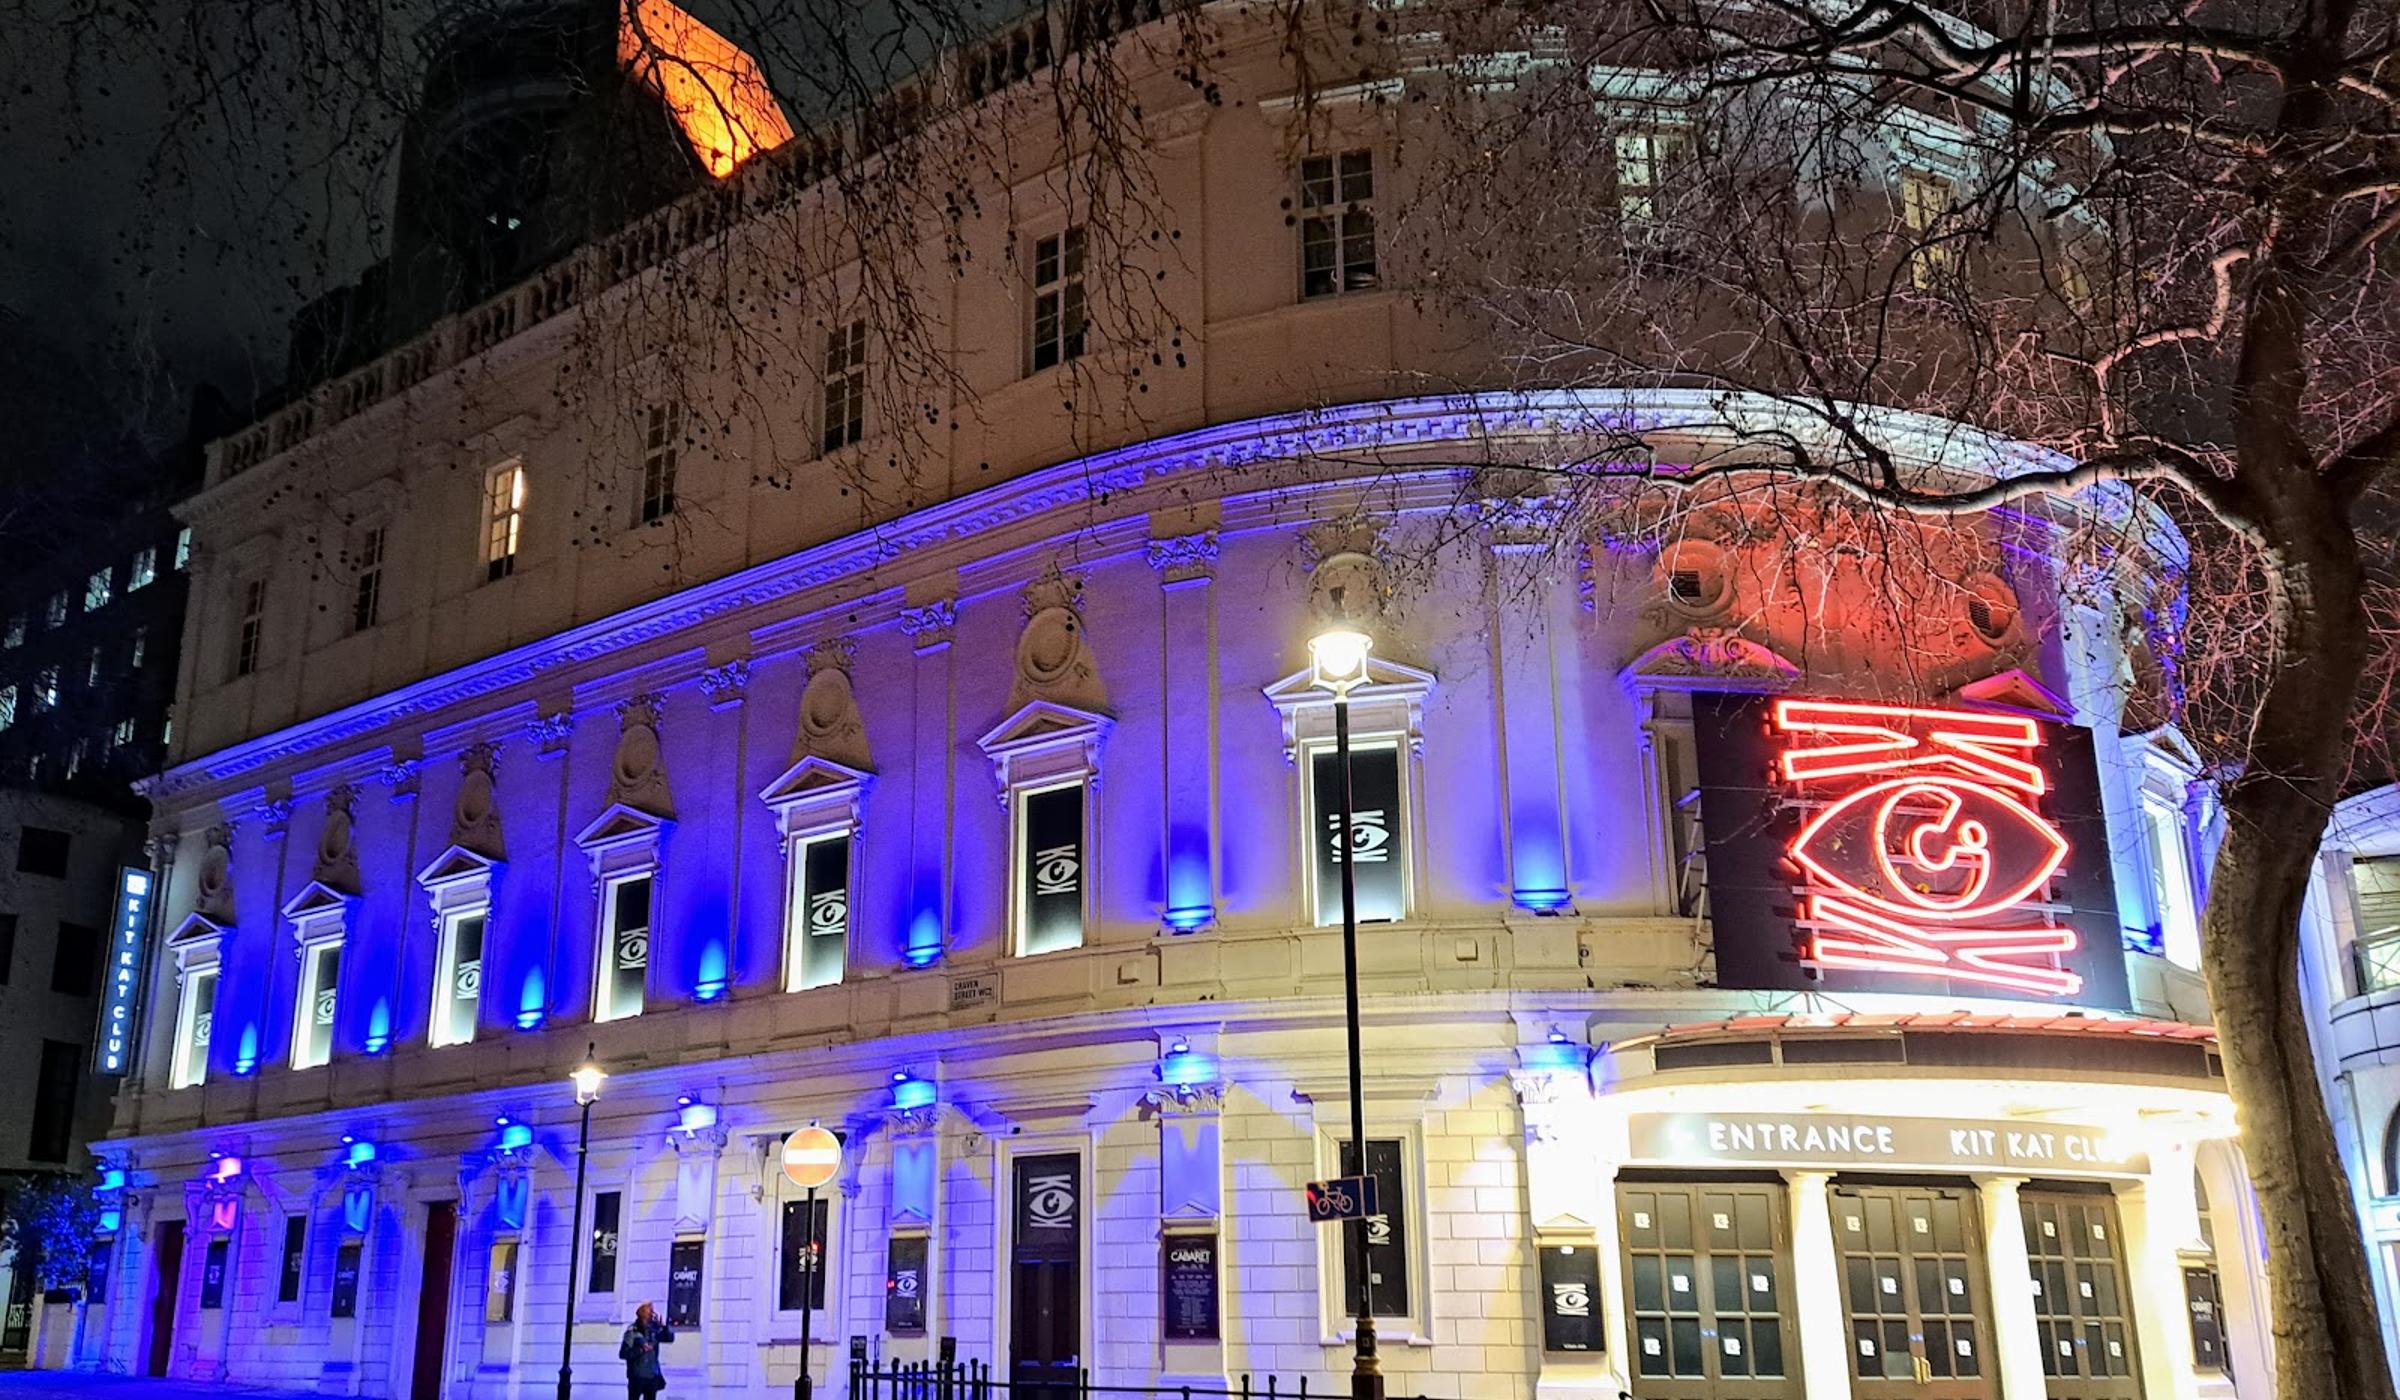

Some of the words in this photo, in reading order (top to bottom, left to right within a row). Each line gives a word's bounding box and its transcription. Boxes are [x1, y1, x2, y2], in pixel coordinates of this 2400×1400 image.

[125, 898, 139, 944] KIT
[118, 951, 133, 998] KAT
[107, 1005, 125, 1069] CLUB
[1708, 1122, 1895, 1153] ENTRANCE
[1950, 1128, 1996, 1156] KIT
[2007, 1132, 2054, 1160] KAT
[1170, 1249, 1211, 1264] CABARET
